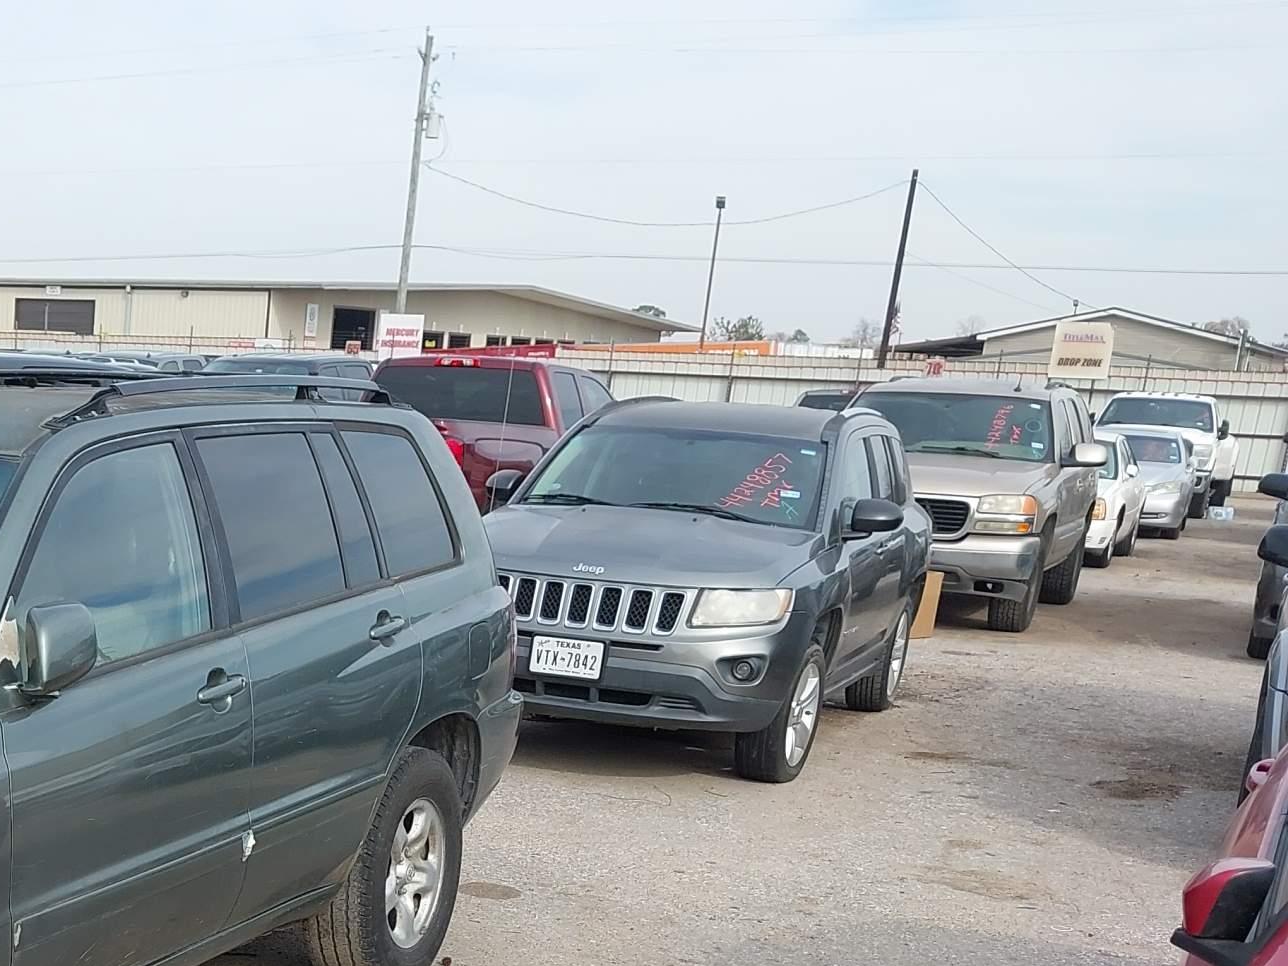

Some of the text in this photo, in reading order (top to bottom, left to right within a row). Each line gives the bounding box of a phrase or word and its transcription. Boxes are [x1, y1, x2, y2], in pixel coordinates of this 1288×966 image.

[385, 327, 420, 337] MERCURY
[380, 339, 420, 348] INSURANCE
[1057, 357, 1103, 368] DROP ZONE
[713, 452, 793, 508] 44248857
[572, 562, 605, 575] Jeep
[555, 640, 582, 650] TEXAS
[536, 649, 598, 671] VTX-7842
